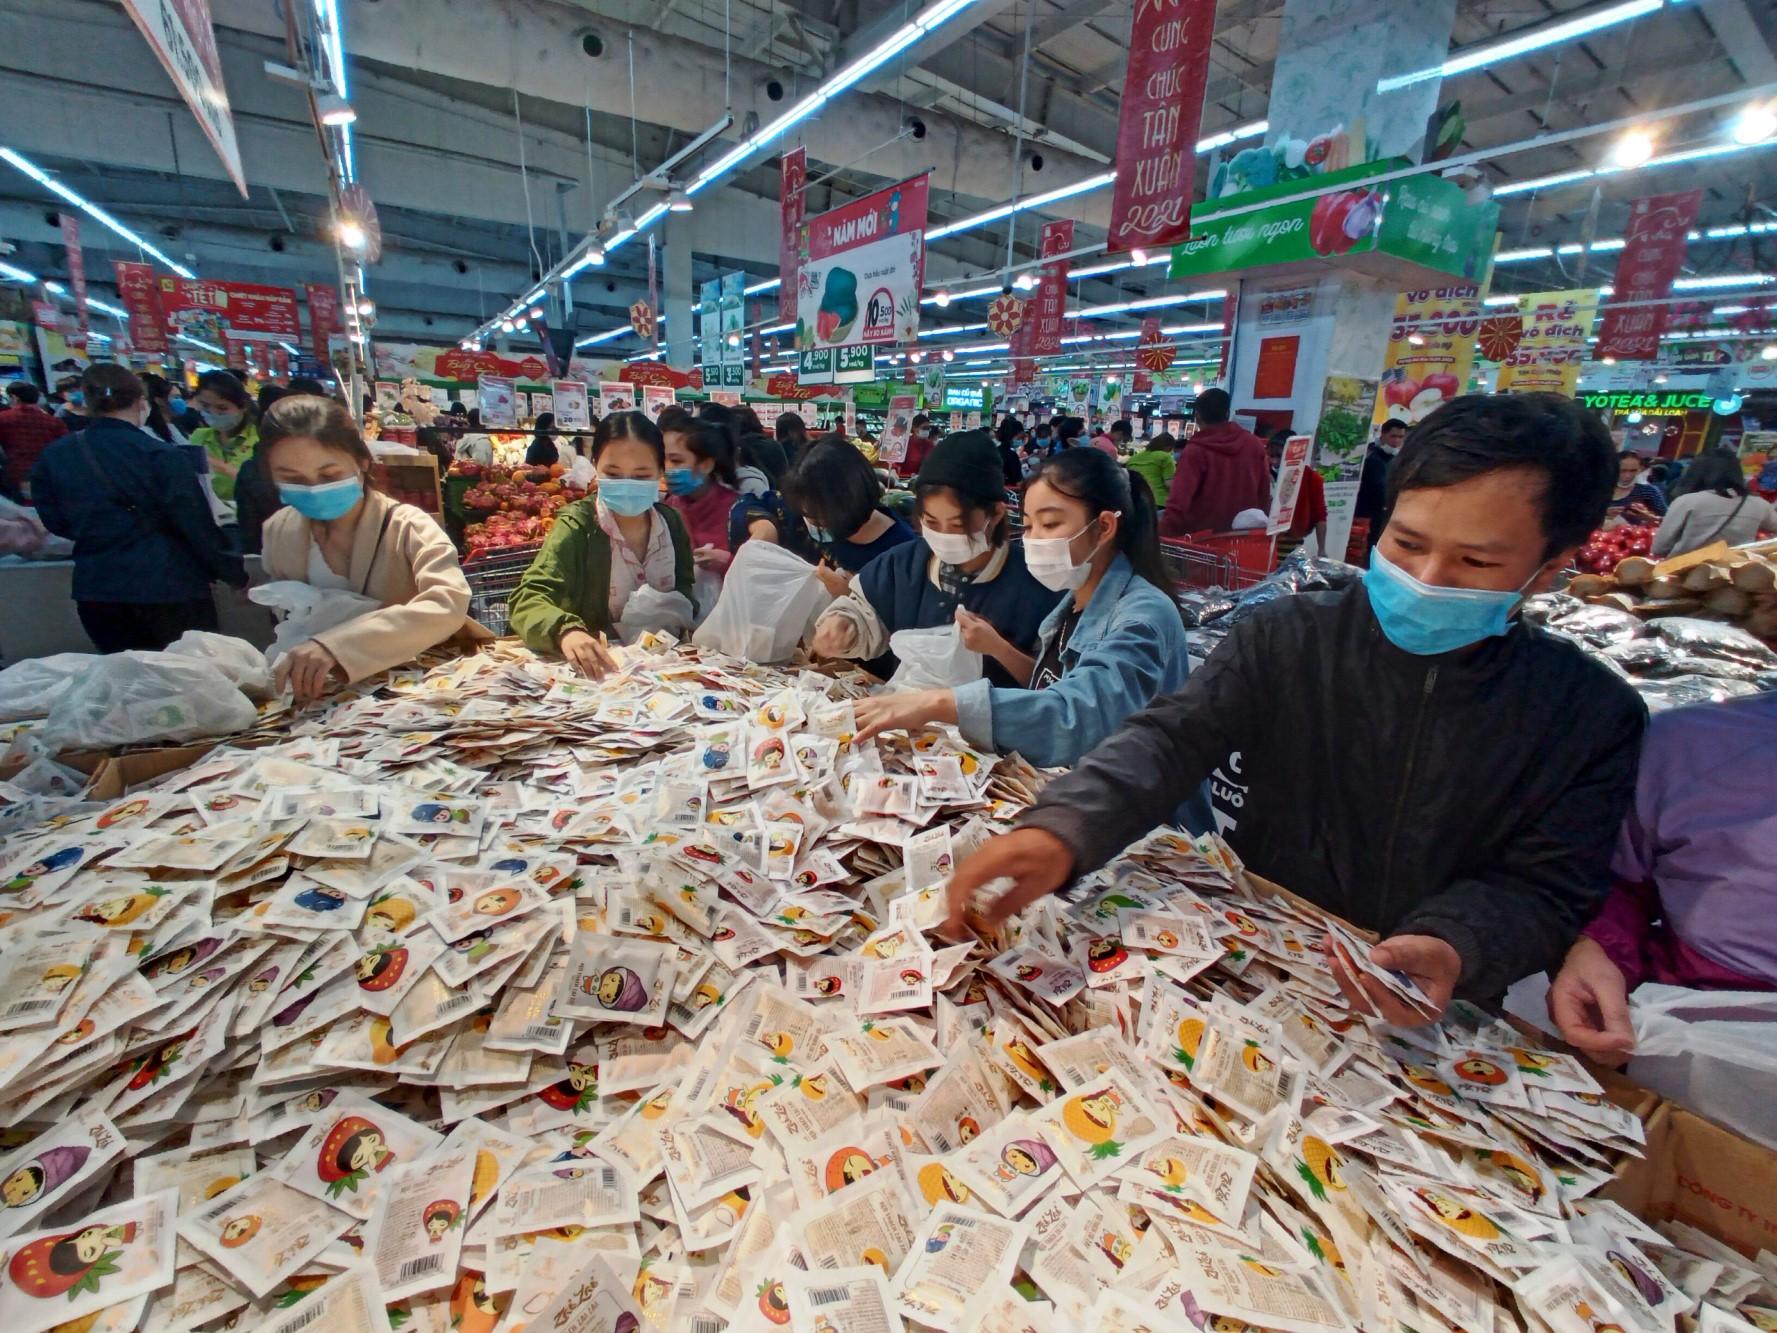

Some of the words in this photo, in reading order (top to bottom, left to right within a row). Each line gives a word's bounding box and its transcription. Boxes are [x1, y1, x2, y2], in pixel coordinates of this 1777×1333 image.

[1147, 62, 1185, 100] CHÚC
[1143, 101, 1181, 149] TÂN
[1131, 147, 1183, 198] XUÂN
